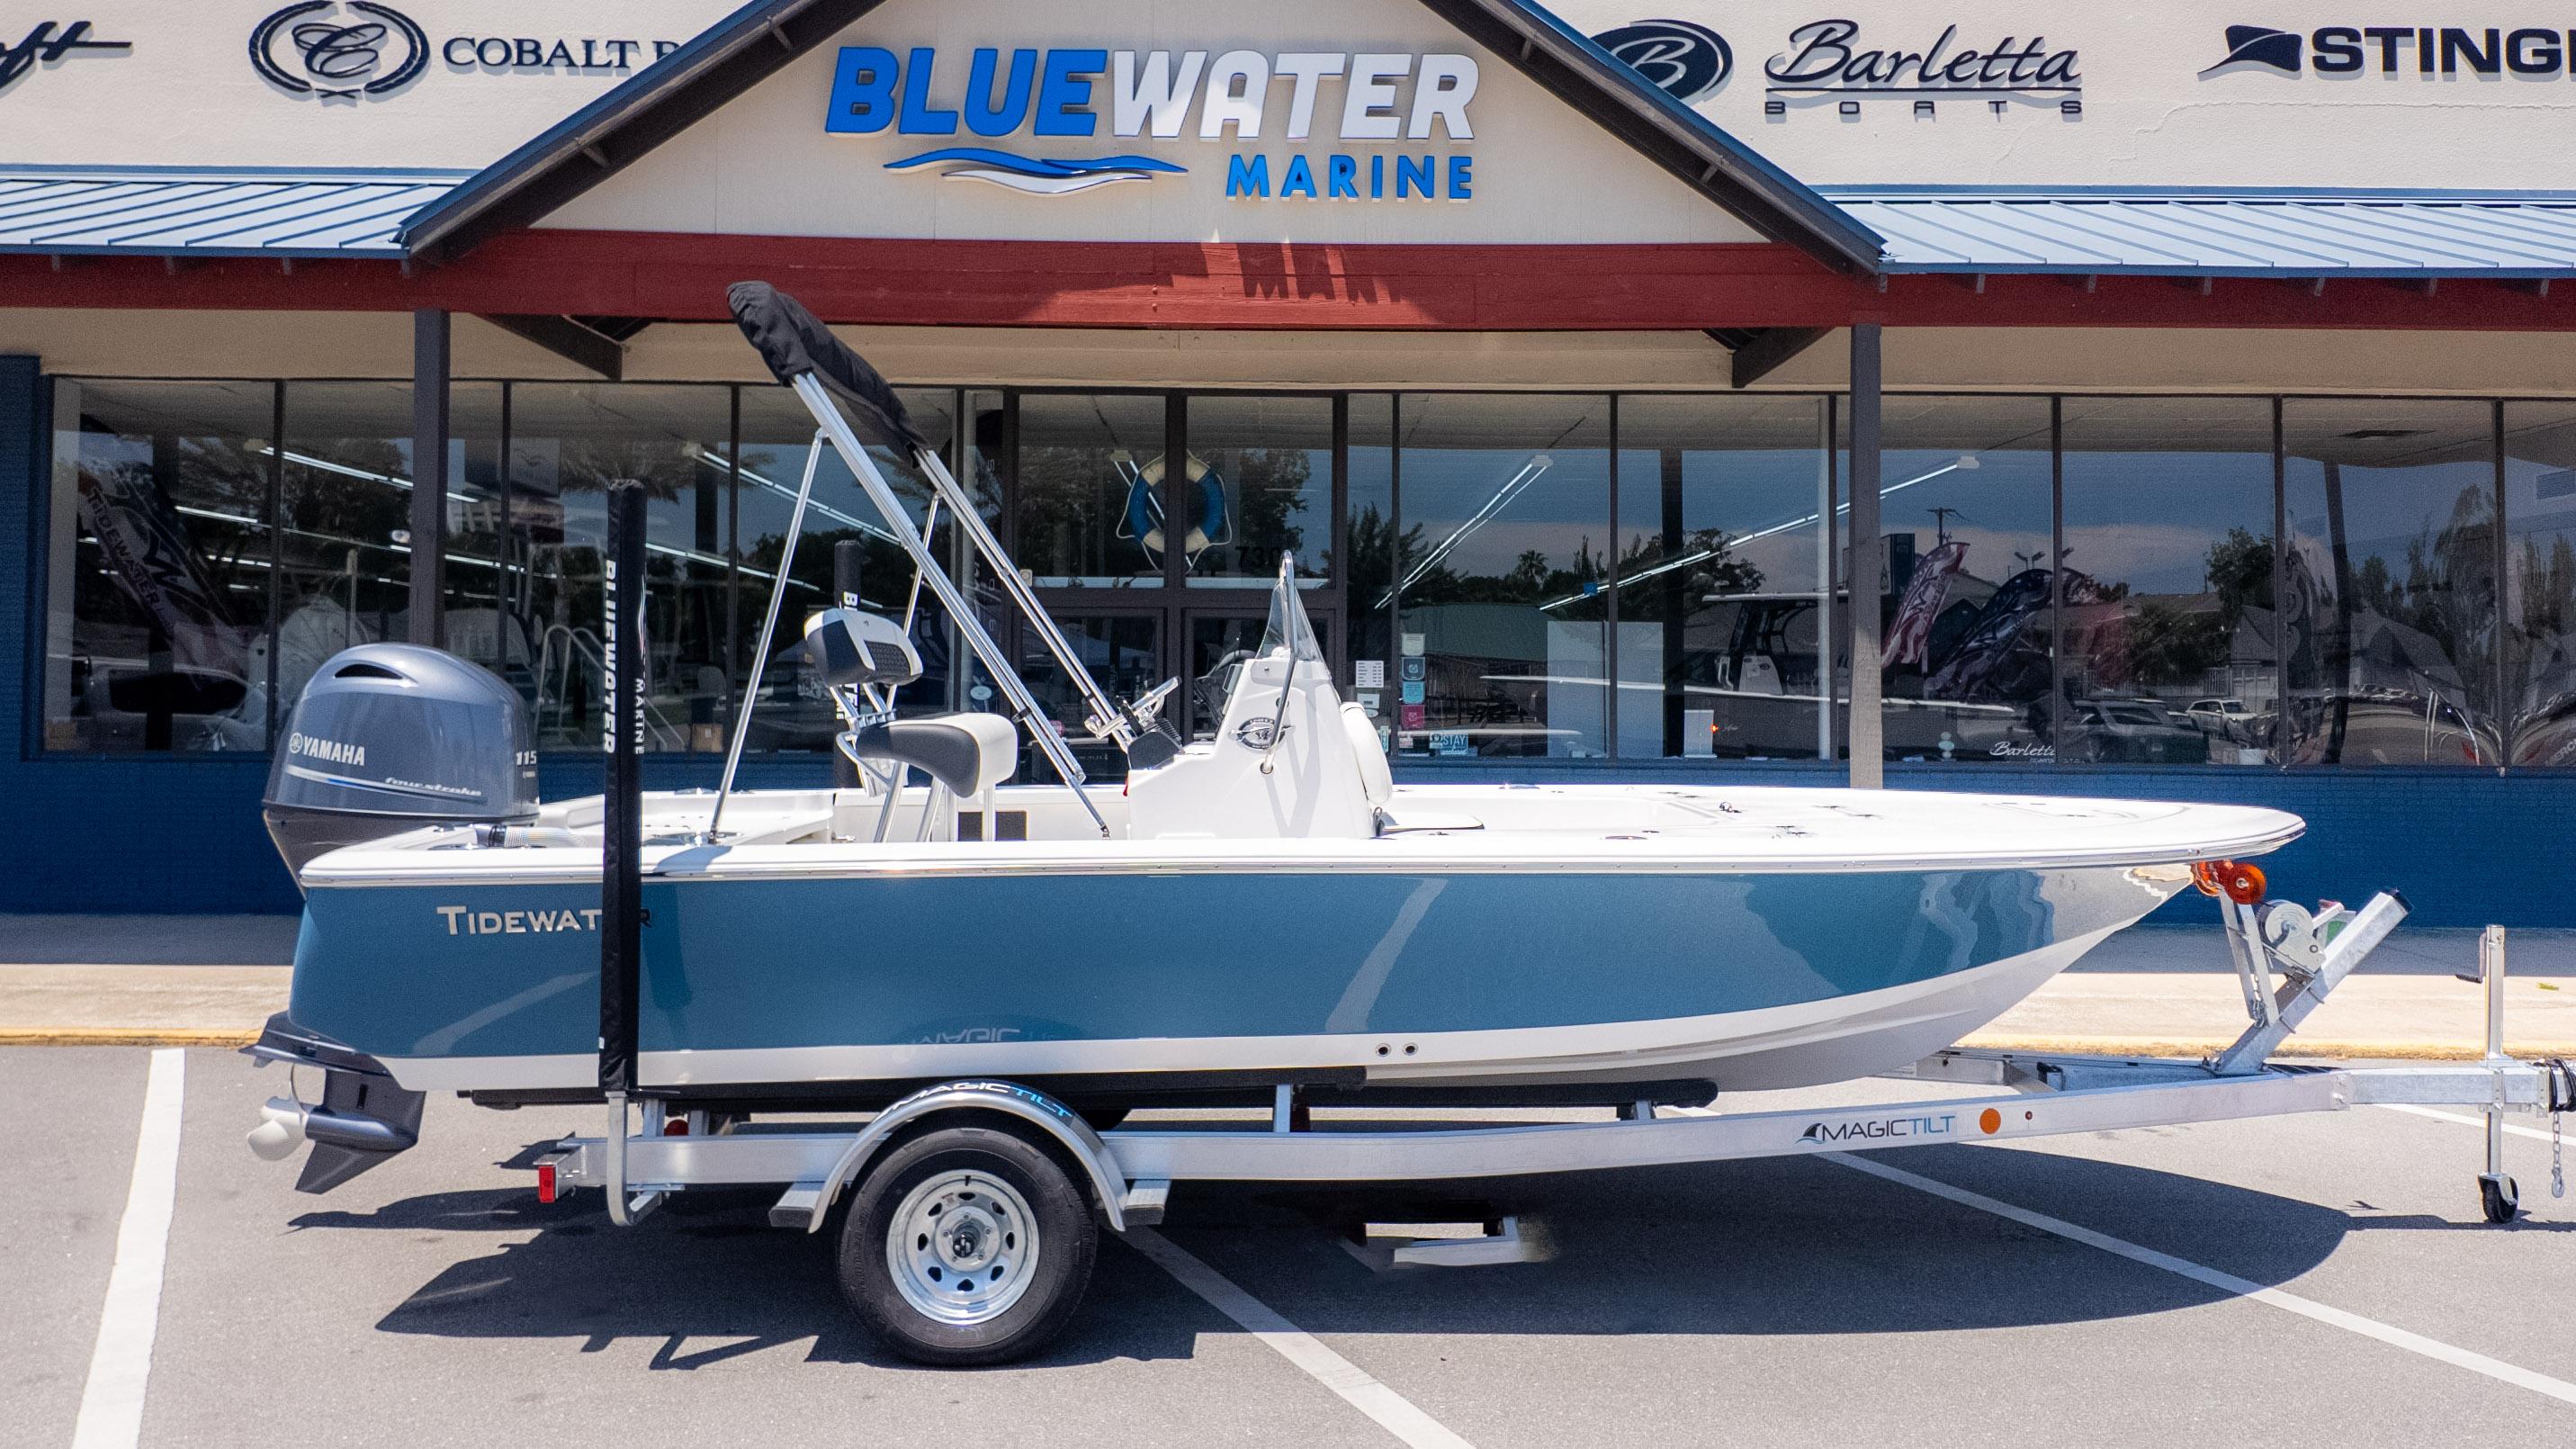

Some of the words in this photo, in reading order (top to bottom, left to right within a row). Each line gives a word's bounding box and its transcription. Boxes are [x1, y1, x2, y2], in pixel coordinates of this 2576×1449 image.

[443, 37, 640, 68] COBALT
[1765, 20, 2082, 84] Barletta
[825, 47, 1480, 140] BLUEWATER
[1764, 100, 2082, 115] BOATS
[1225, 154, 1473, 199] MARINE
[634, 678, 646, 755] MARINE
[302, 734, 365, 767] YAMAHA
[1442, 734, 1466, 746] STAY
[516, 750, 537, 765] 115
[436, 904, 652, 935] TIDEWATR
[1822, 1115, 1955, 1145] MAGICTILT
